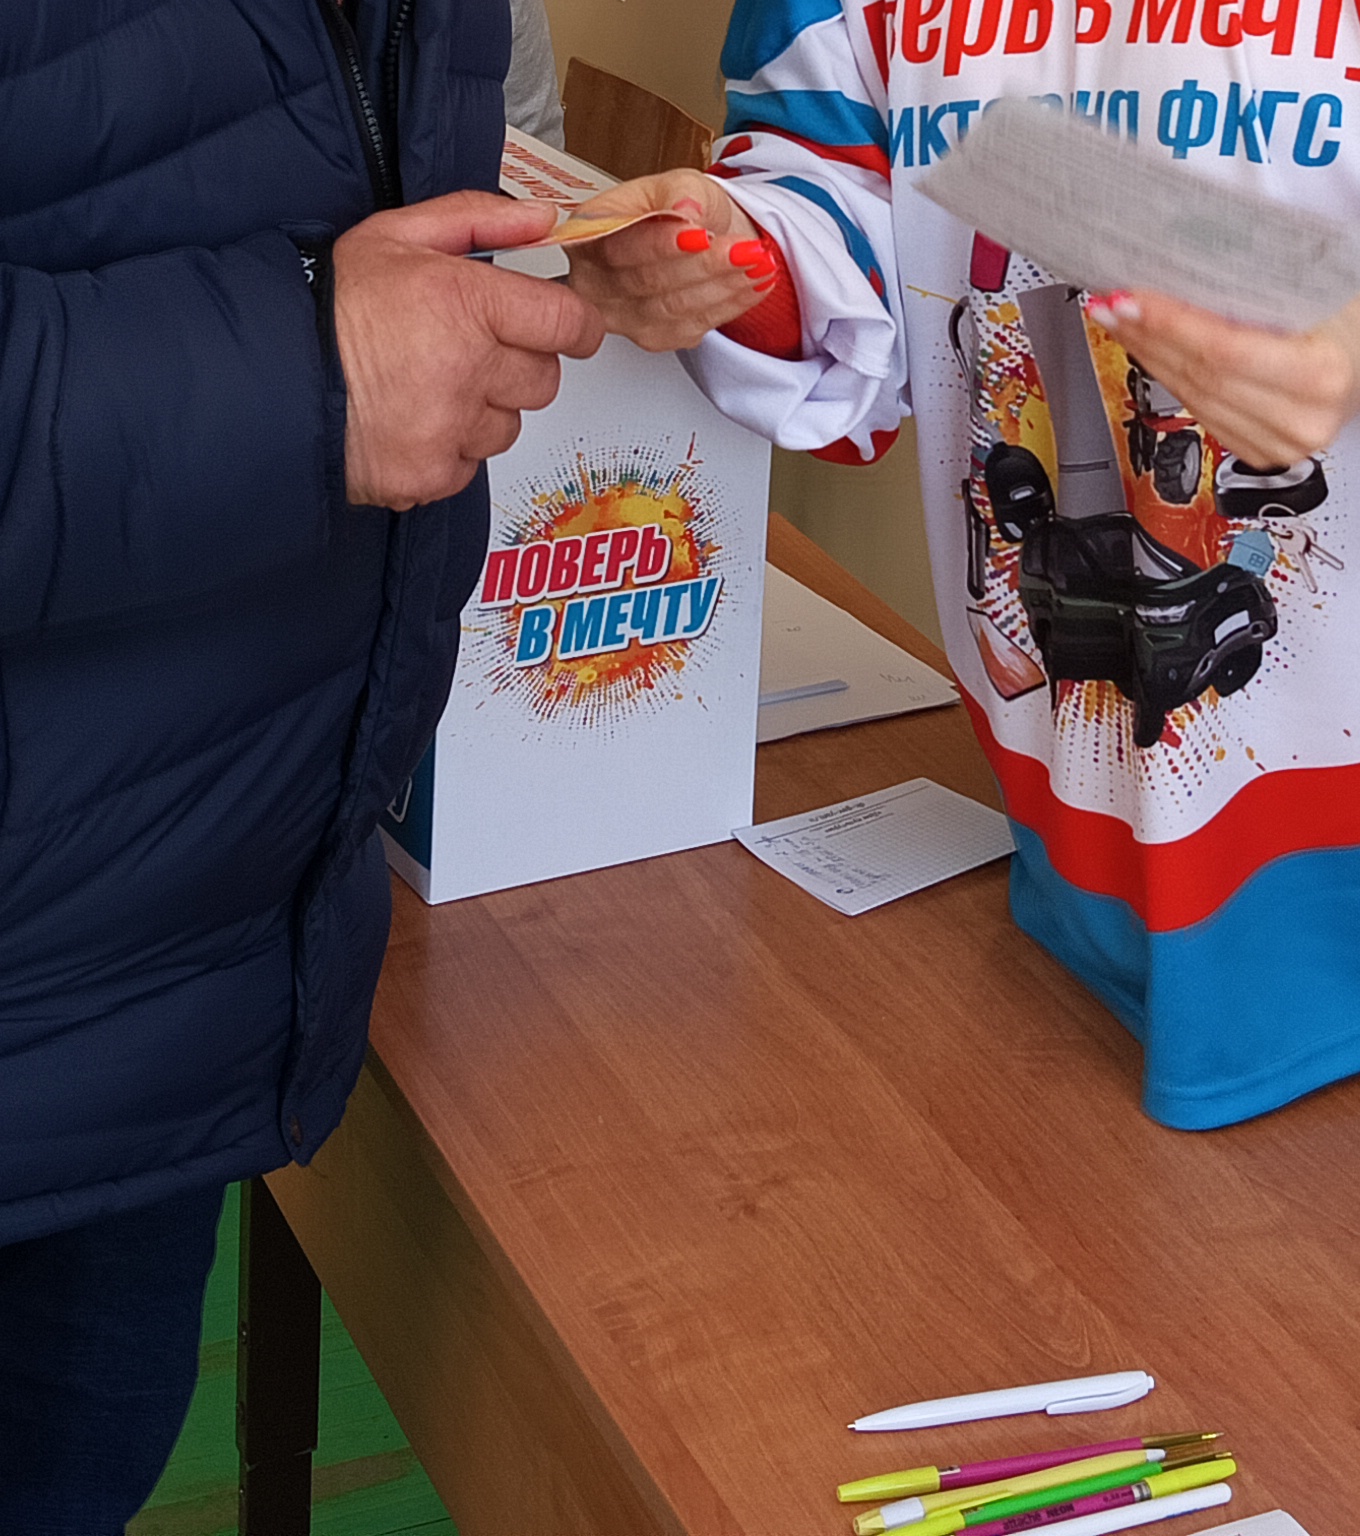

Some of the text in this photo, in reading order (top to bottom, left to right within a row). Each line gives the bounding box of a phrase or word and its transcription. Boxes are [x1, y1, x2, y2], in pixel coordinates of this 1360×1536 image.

[1156, 79, 1343, 168] ФКГС
[480, 526, 671, 607] ПОВЕРЬ
[514, 576, 723, 667] В МЕЧТУ
